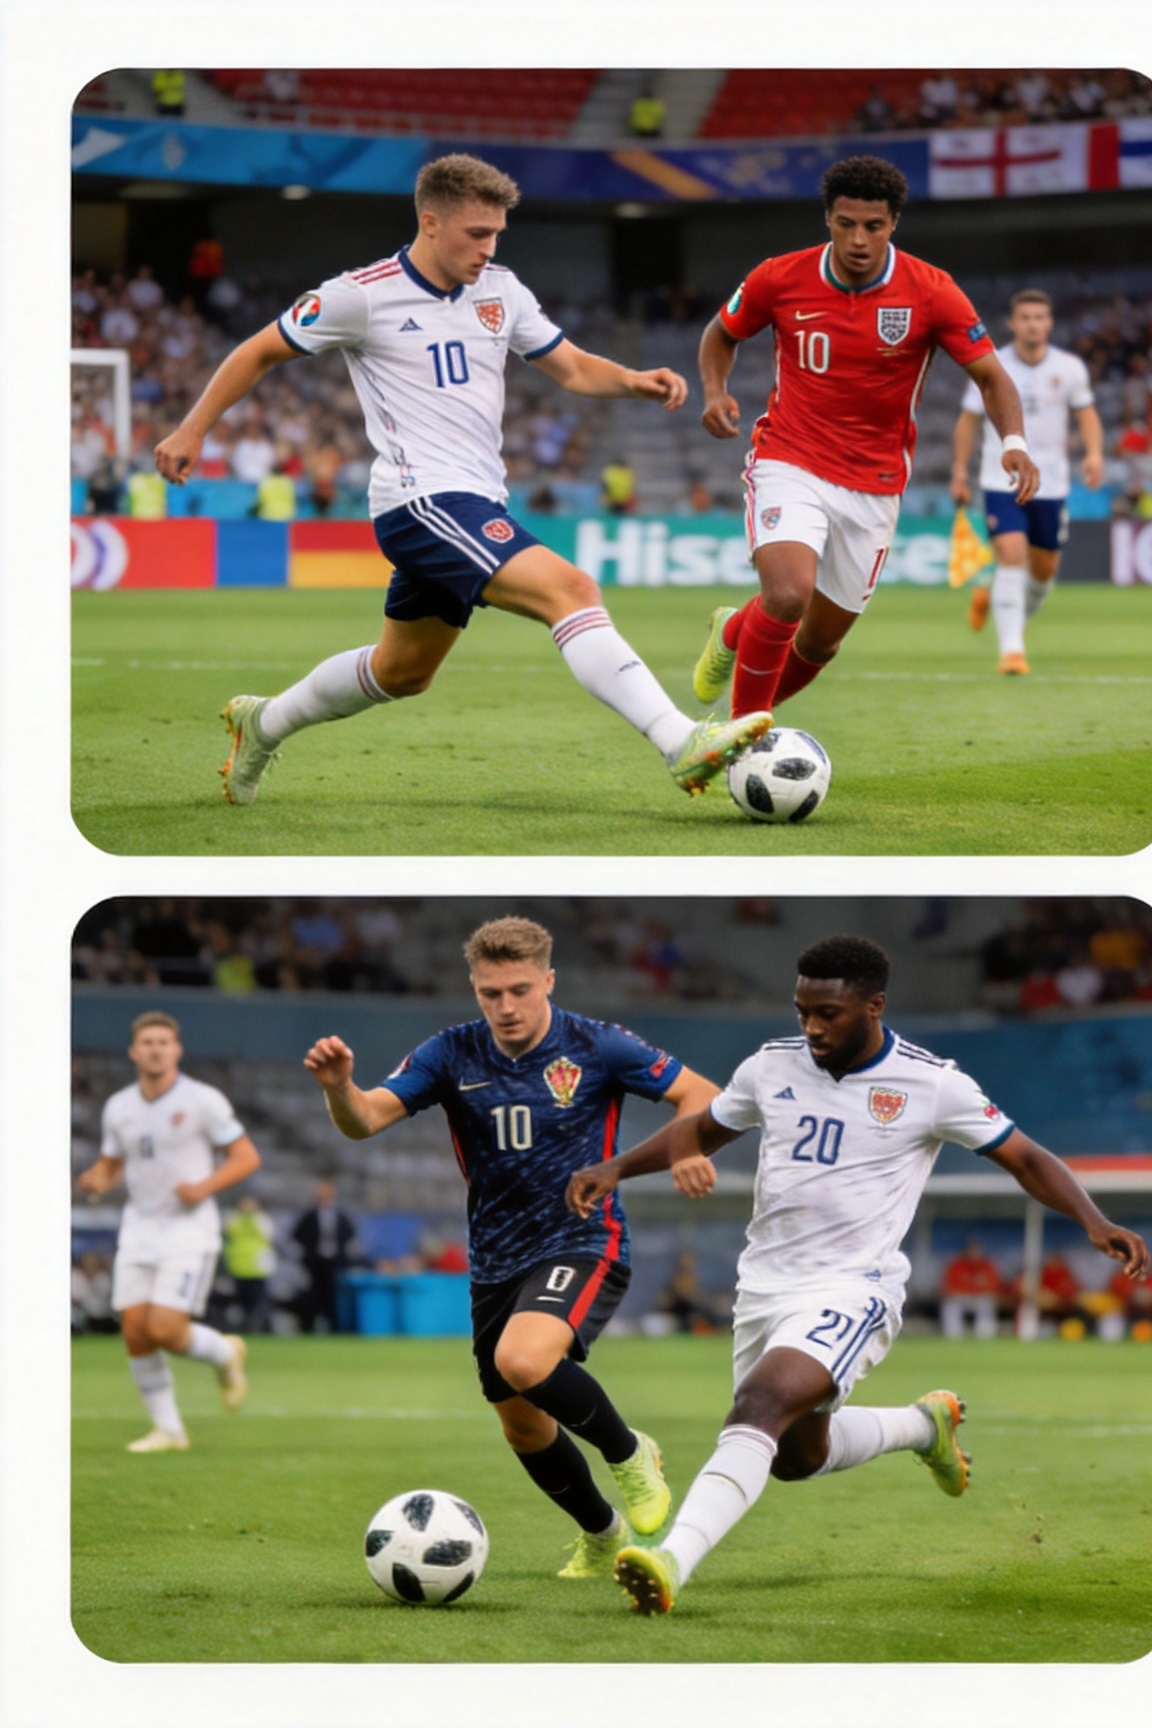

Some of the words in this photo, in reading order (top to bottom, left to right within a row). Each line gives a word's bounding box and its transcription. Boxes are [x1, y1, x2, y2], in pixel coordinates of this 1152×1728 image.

[426, 340, 469, 388] 10
[794, 330, 830, 374] 10
[490, 1105, 532, 1150] 10
[792, 1115, 845, 1166] 20
